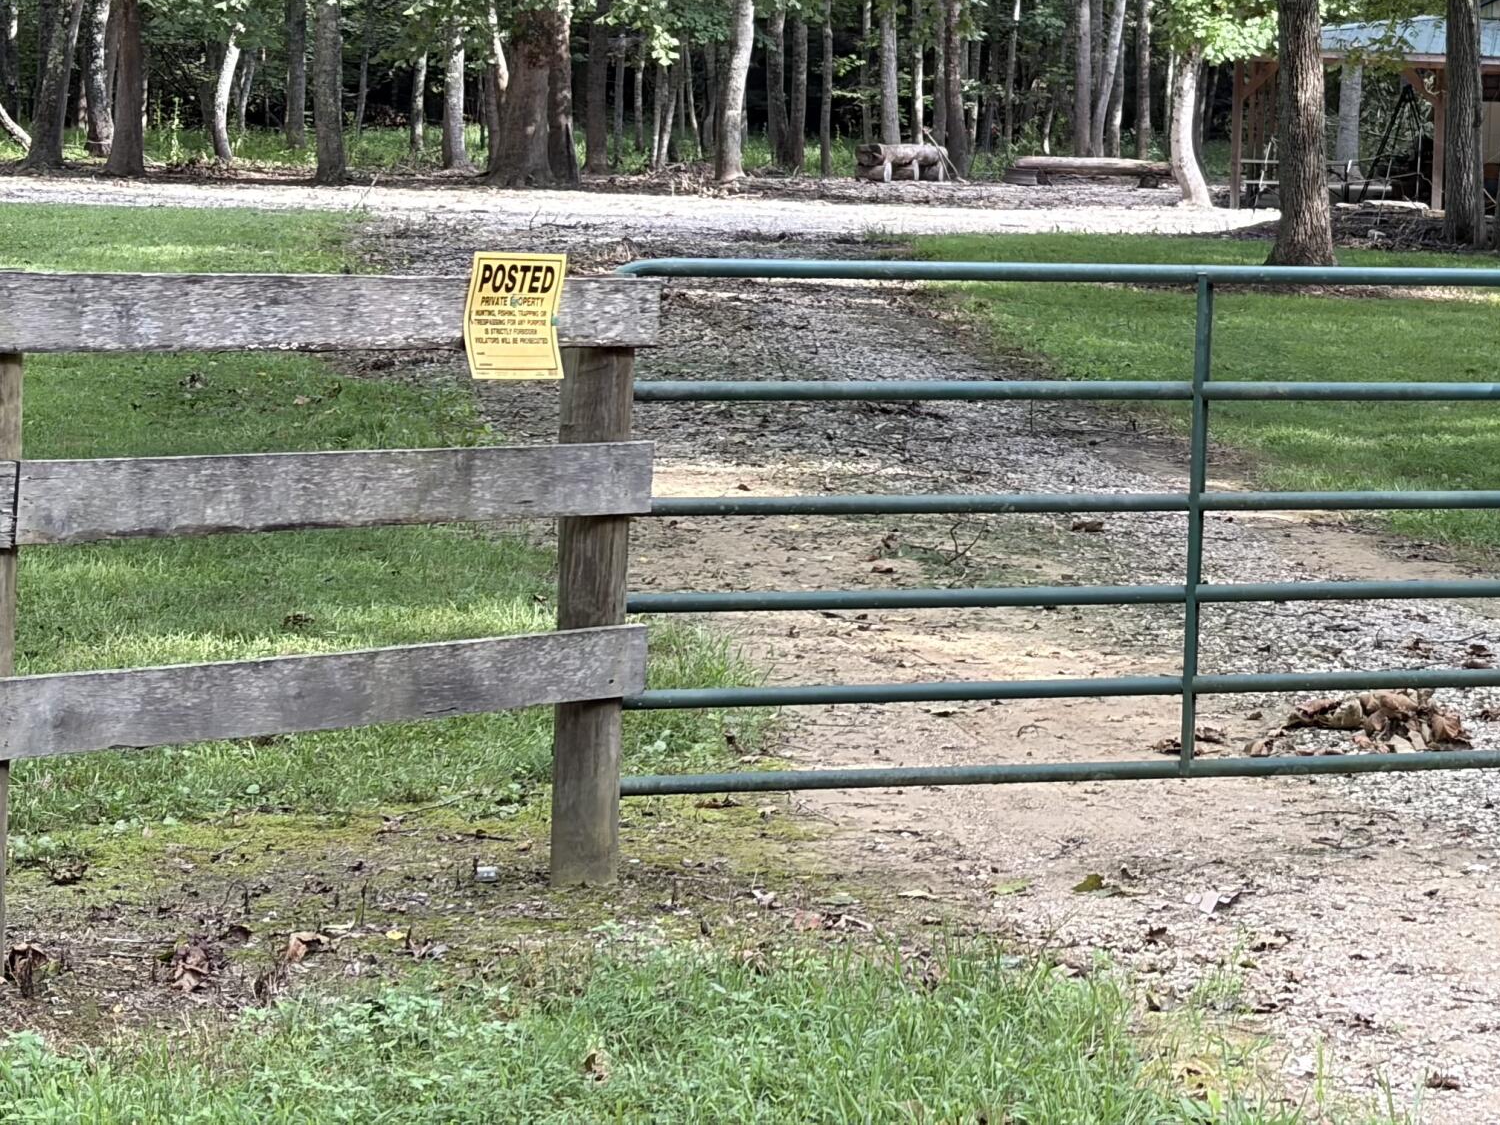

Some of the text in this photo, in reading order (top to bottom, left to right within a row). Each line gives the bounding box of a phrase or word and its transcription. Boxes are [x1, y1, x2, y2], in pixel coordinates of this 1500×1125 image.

[478, 263, 555, 294] POSTED
[480, 296, 545, 307] PRIVATE POPERTY
